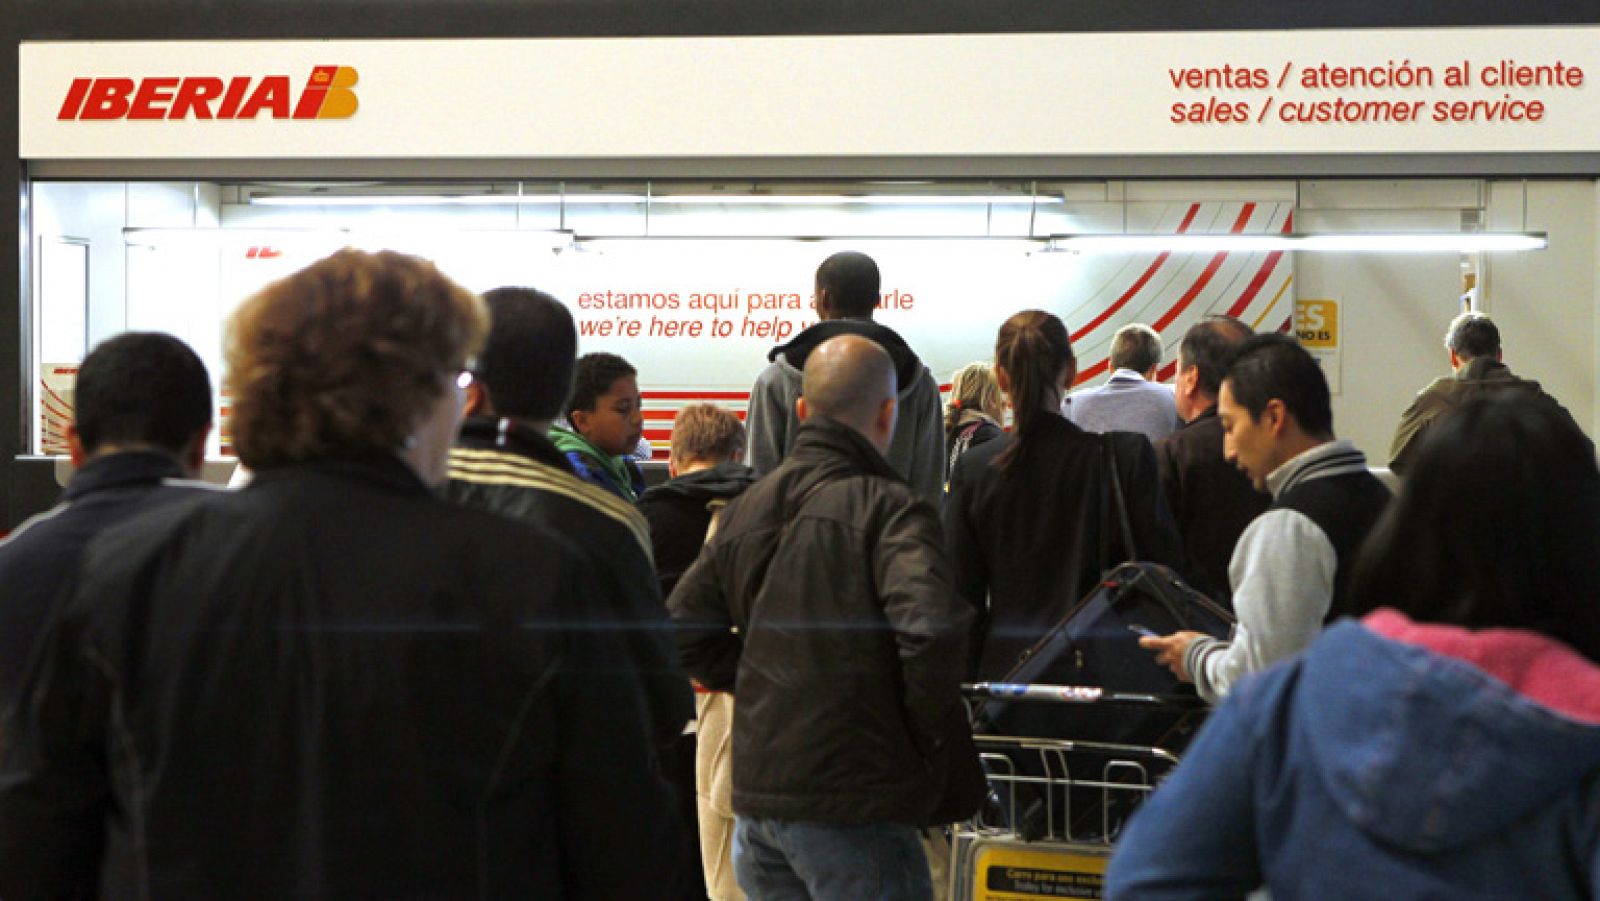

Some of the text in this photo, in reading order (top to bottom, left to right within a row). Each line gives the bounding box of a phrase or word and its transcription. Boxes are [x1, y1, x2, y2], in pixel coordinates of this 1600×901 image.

[1169, 59, 1585, 90] ventas / atención al cliente
[57, 75, 291, 120] IBERIA
[1170, 94, 1545, 124] sales / customer service
[577, 290, 681, 310] estamos
[688, 287, 740, 312] aquí
[747, 293, 801, 312] para
[579, 316, 642, 337] we're
[649, 316, 703, 337] here
[711, 318, 734, 337] to
[741, 317, 793, 342] help
